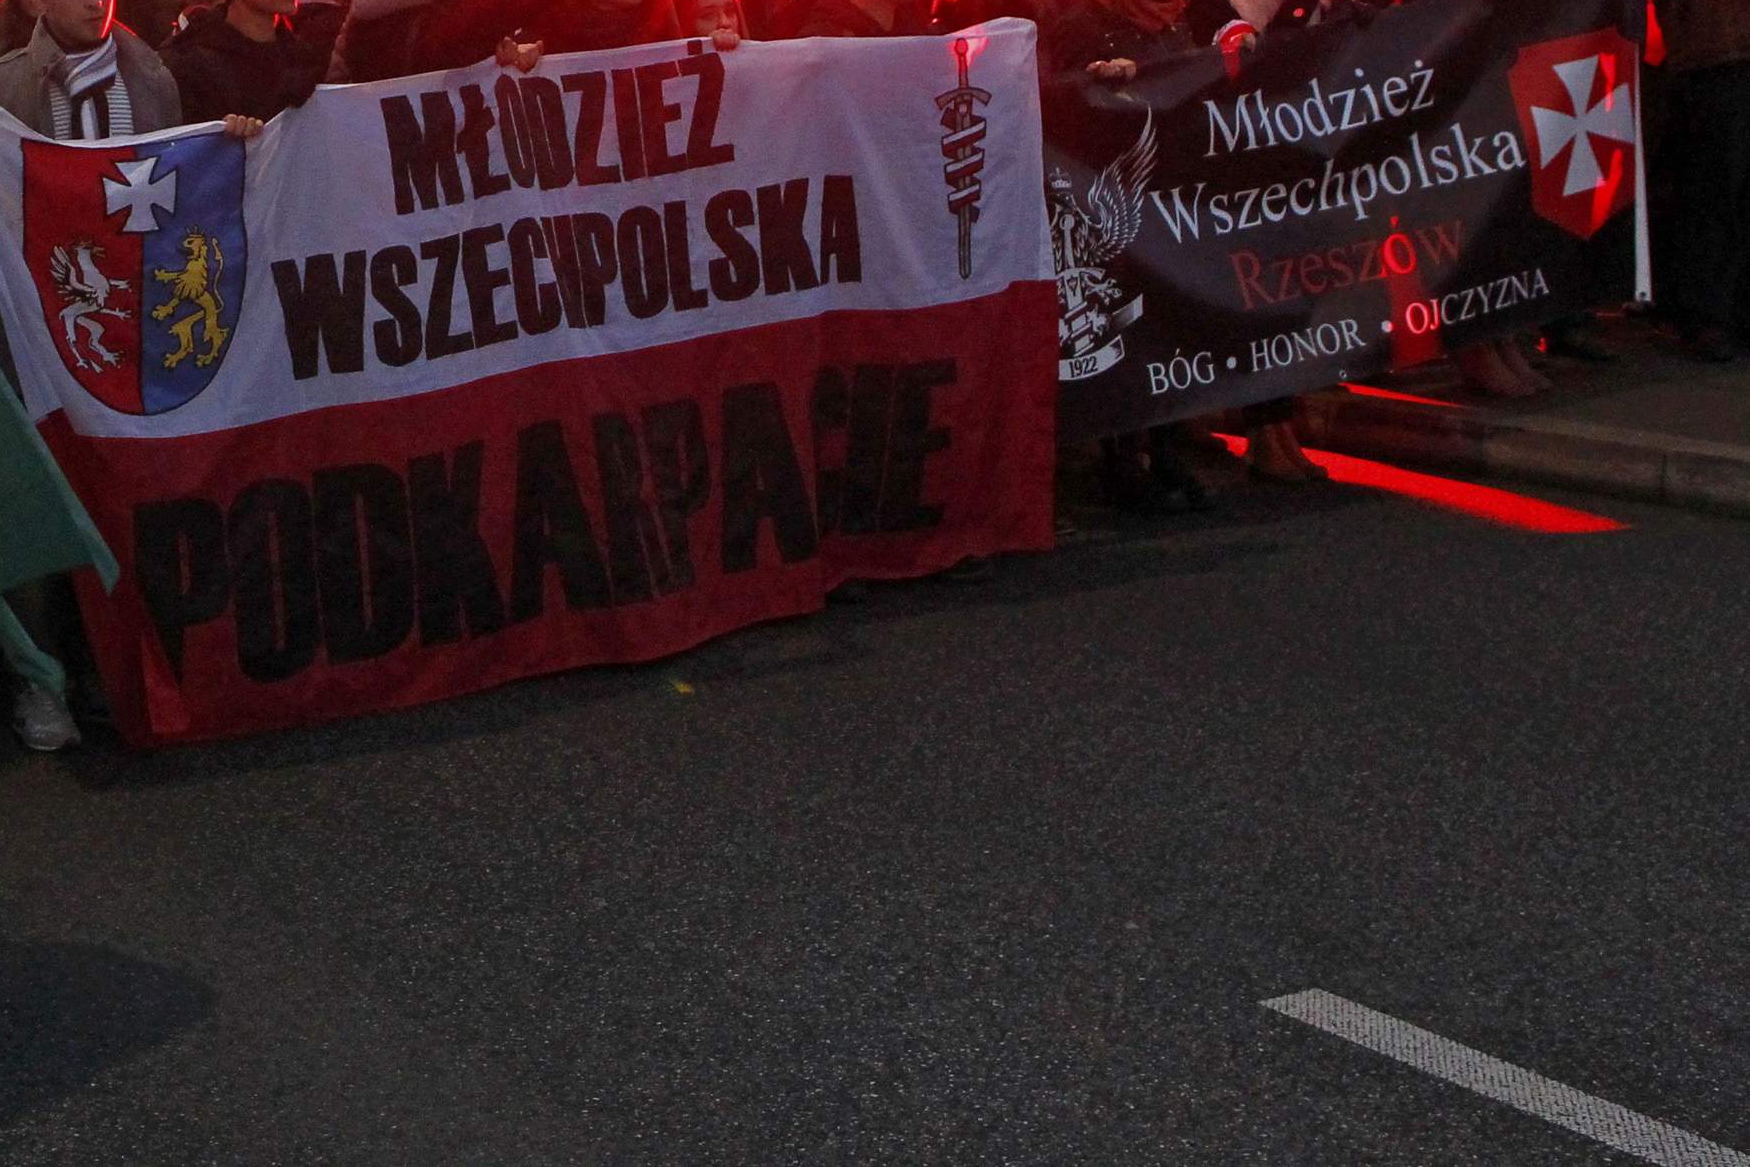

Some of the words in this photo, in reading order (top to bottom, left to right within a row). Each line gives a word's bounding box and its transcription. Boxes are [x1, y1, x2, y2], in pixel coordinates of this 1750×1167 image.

[380, 39, 735, 216] MŁODZIEŻ
[1202, 59, 1436, 158] Młodzież
[1150, 122, 1526, 245] Wszechpolska
[1229, 216, 1464, 313] Rzeszów
[1068, 356, 1099, 378] 1922
[1148, 349, 1216, 397] BÓG
[1250, 318, 1366, 375] HONOR
[1405, 267, 1550, 335] OJCZYZNA
